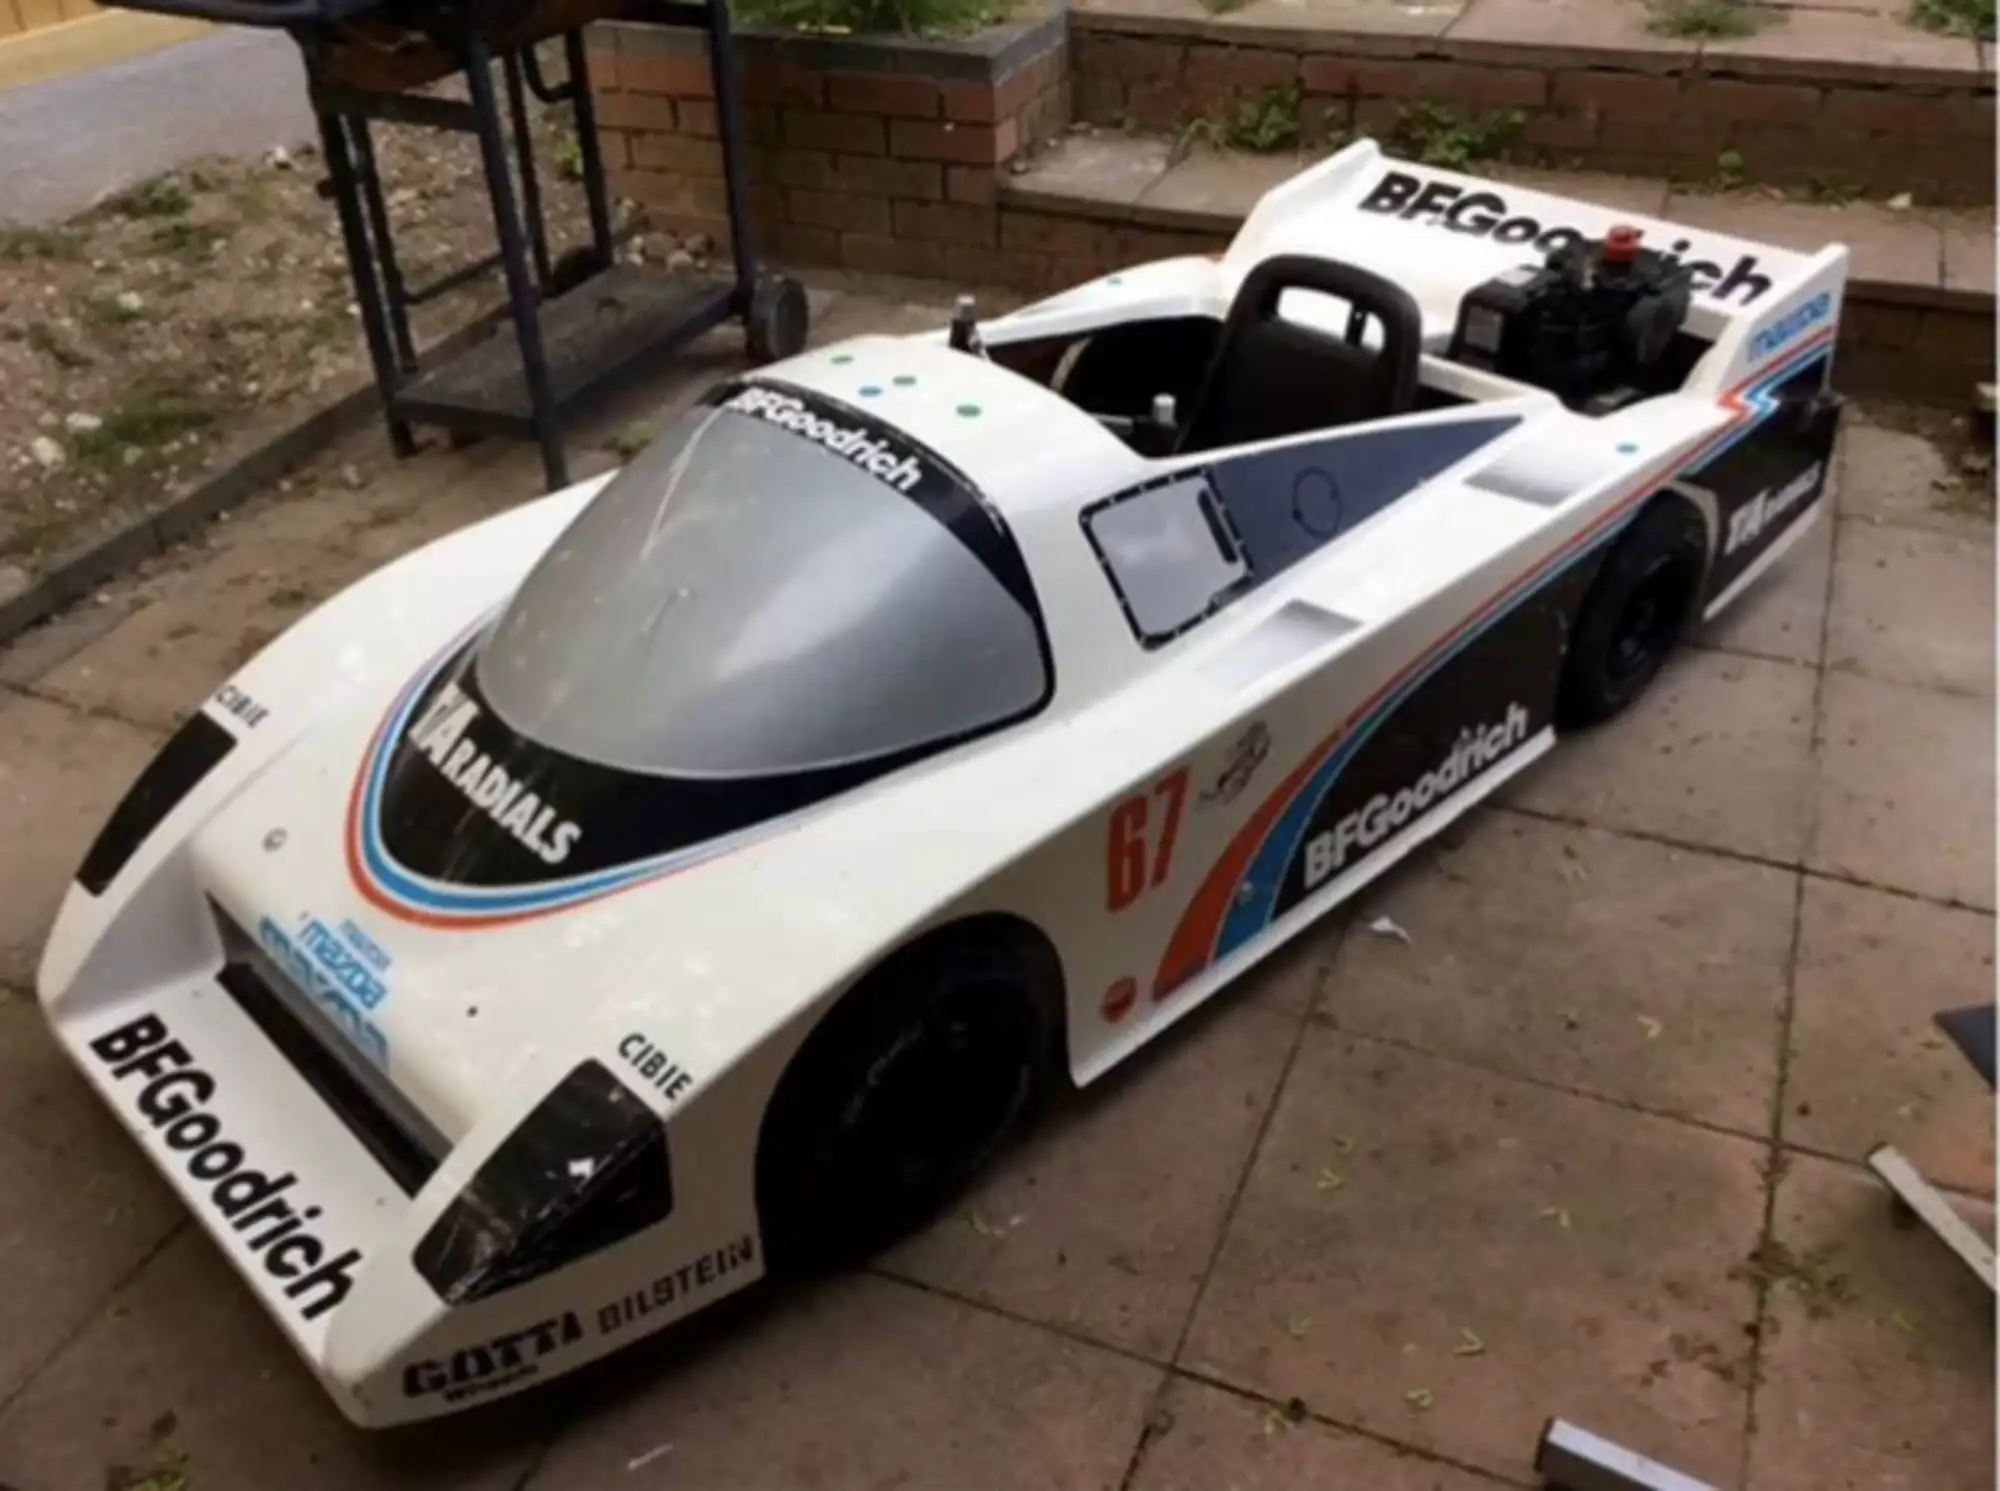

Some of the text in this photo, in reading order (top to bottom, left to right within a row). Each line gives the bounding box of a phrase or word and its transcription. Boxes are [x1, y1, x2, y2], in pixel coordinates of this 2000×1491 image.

[1106, 765, 1189, 913] 67
[1304, 701, 1529, 889] BFGoodrich
[299, 919, 387, 1010] mazda
[618, 1032, 694, 1101] CIBIE
[89, 1012, 363, 1321] BFGoodrich
[596, 1234, 754, 1334] BILSTEIN
